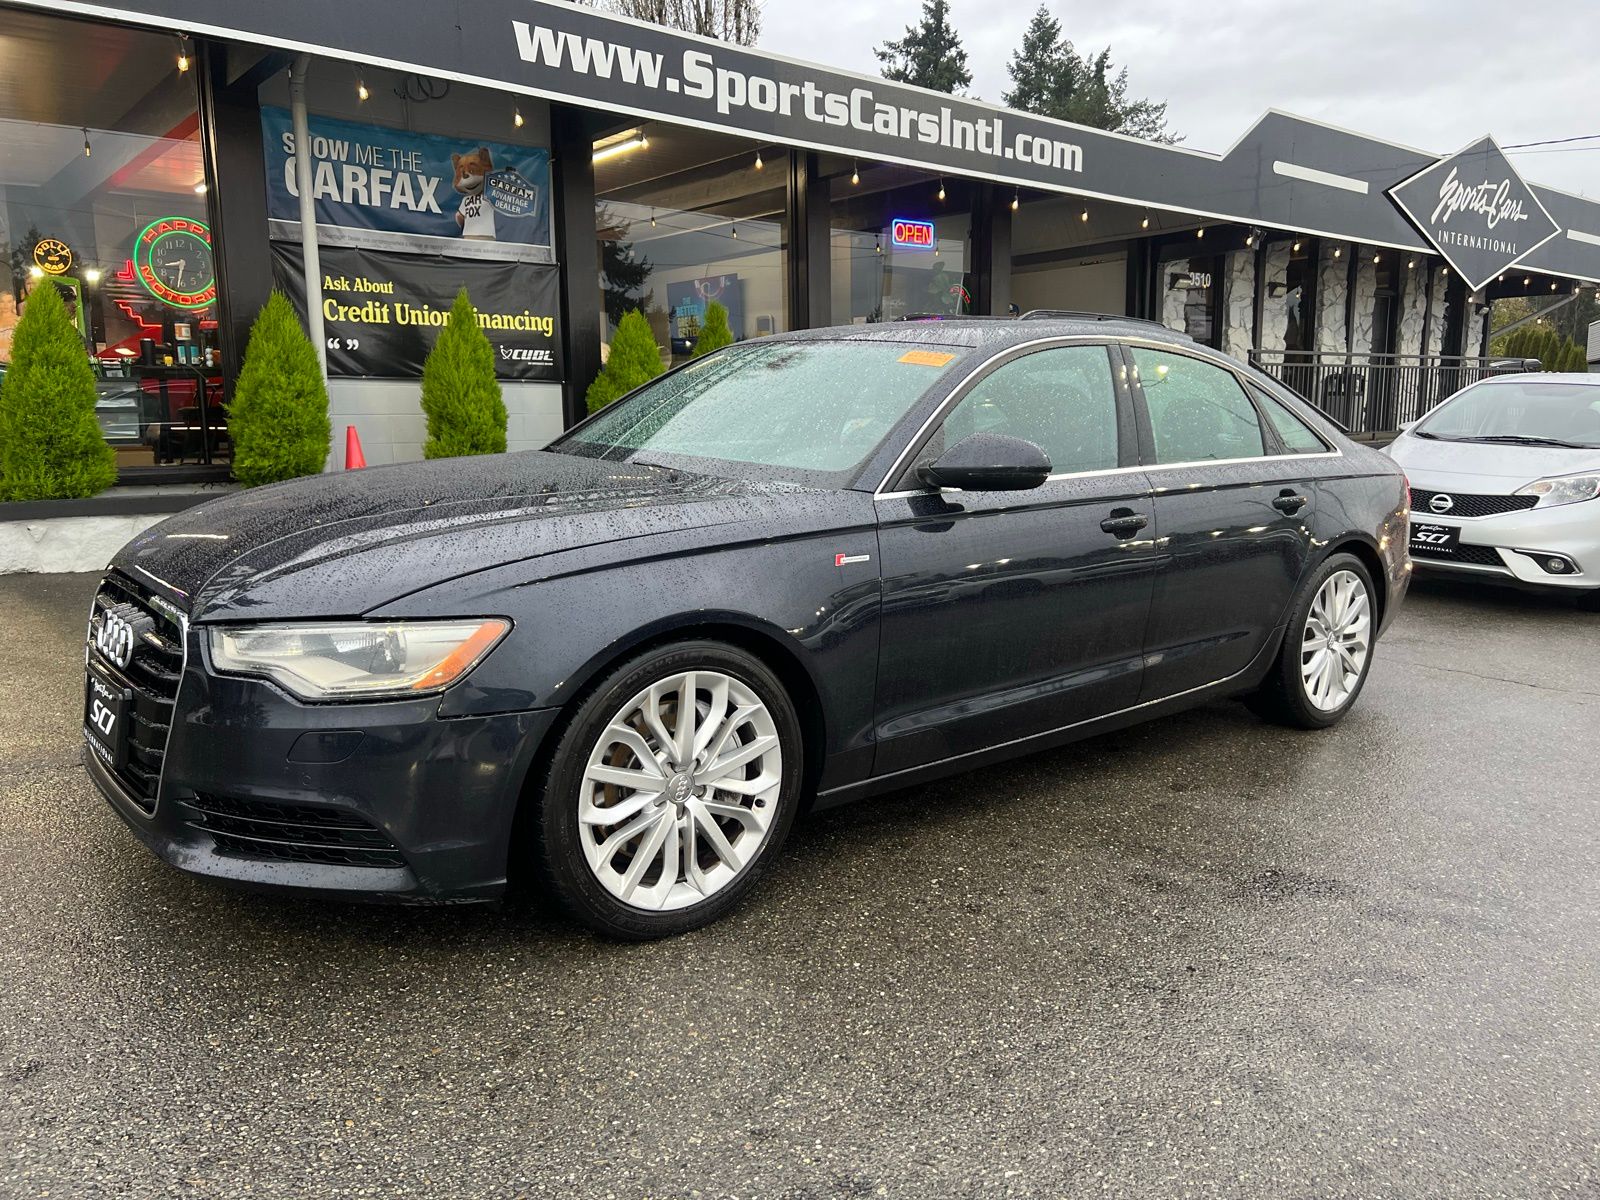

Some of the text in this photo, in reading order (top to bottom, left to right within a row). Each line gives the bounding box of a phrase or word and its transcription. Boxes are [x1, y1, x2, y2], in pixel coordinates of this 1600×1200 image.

[511, 20, 1083, 173] www.SportsCarsIntl.com
[281, 132, 423, 173] SOW ME THE
[489, 179, 533, 200] CARFAX
[491, 190, 529, 208] ADVANTAGE
[1430, 166, 1529, 229] Sports Cars
[464, 205, 481, 218] FOX
[495, 200, 521, 214] DEALER
[894, 222, 933, 244] OPEN
[1438, 229, 1517, 255] INTERNATIONAL
[35, 240, 70, 257] POLLY
[175, 239, 185, 248] 12
[43, 262, 65, 271] GAS
[323, 275, 394, 294] Ask About
[323, 299, 390, 324] Credit
[472, 307, 554, 337] inancing
[511, 349, 554, 361] CUDL
[1411, 531, 1451, 544] SCI
[90, 698, 116, 736] SCI
